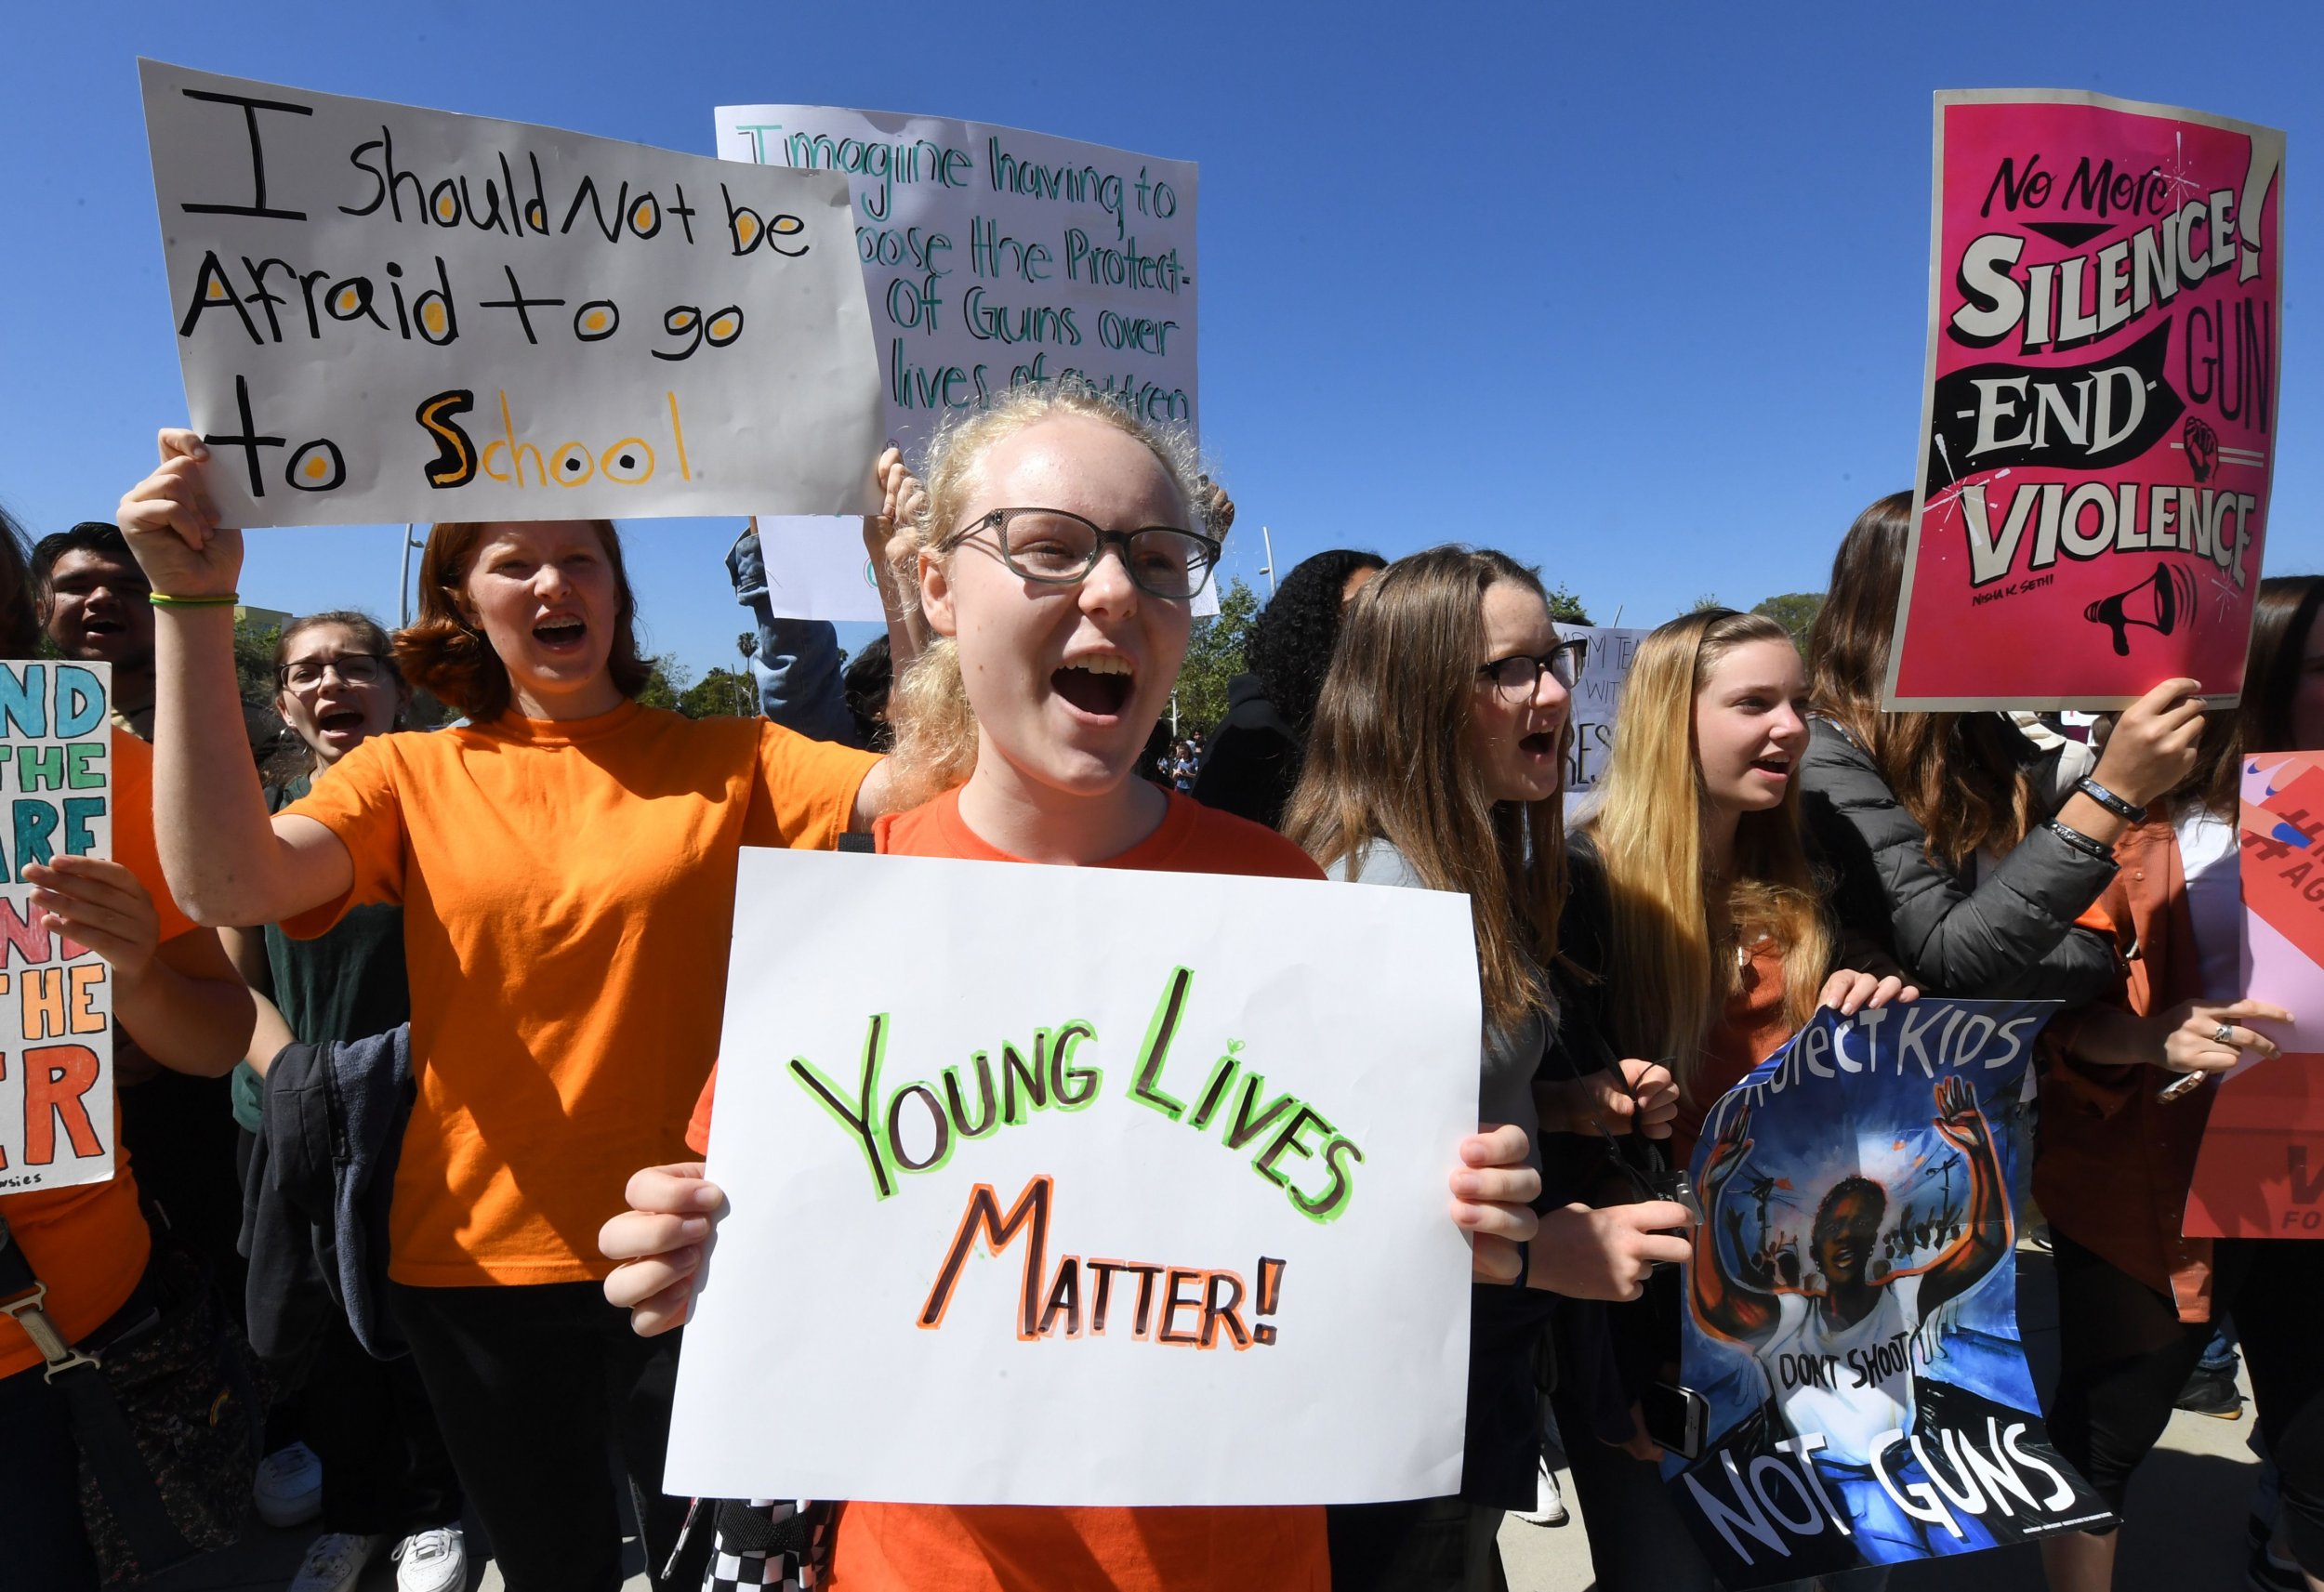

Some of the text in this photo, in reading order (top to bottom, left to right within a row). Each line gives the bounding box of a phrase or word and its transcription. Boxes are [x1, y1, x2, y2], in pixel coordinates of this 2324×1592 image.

[181, 88, 313, 221] I
[561, 174, 695, 244] Not
[720, 182, 810, 257] be
[735, 125, 1176, 241] Imagine having to
[1980, 153, 2168, 218] No More
[971, 215, 1052, 283] the
[178, 249, 745, 361] Afraid to go
[964, 285, 1081, 344] Guns
[1098, 309, 1180, 357] over
[891, 337, 991, 410] lives
[2185, 296, 2269, 434] GUN
[204, 375, 691, 497] to School
[1961, 481, 2256, 588] VIOLENCE
[1972, 588, 2003, 607] NISHA
[2019, 573, 2053, 594] SETHI
[0, 796, 107, 884] RE
[0, 963, 107, 1040] HE
[1897, 1005, 2037, 1079] KIDS
[915, 1173, 1287, 1352] MATTER!
[1779, 1330, 1909, 1390] DONT SHOOT
[1683, 1416, 2077, 1566] NOT GUNS
